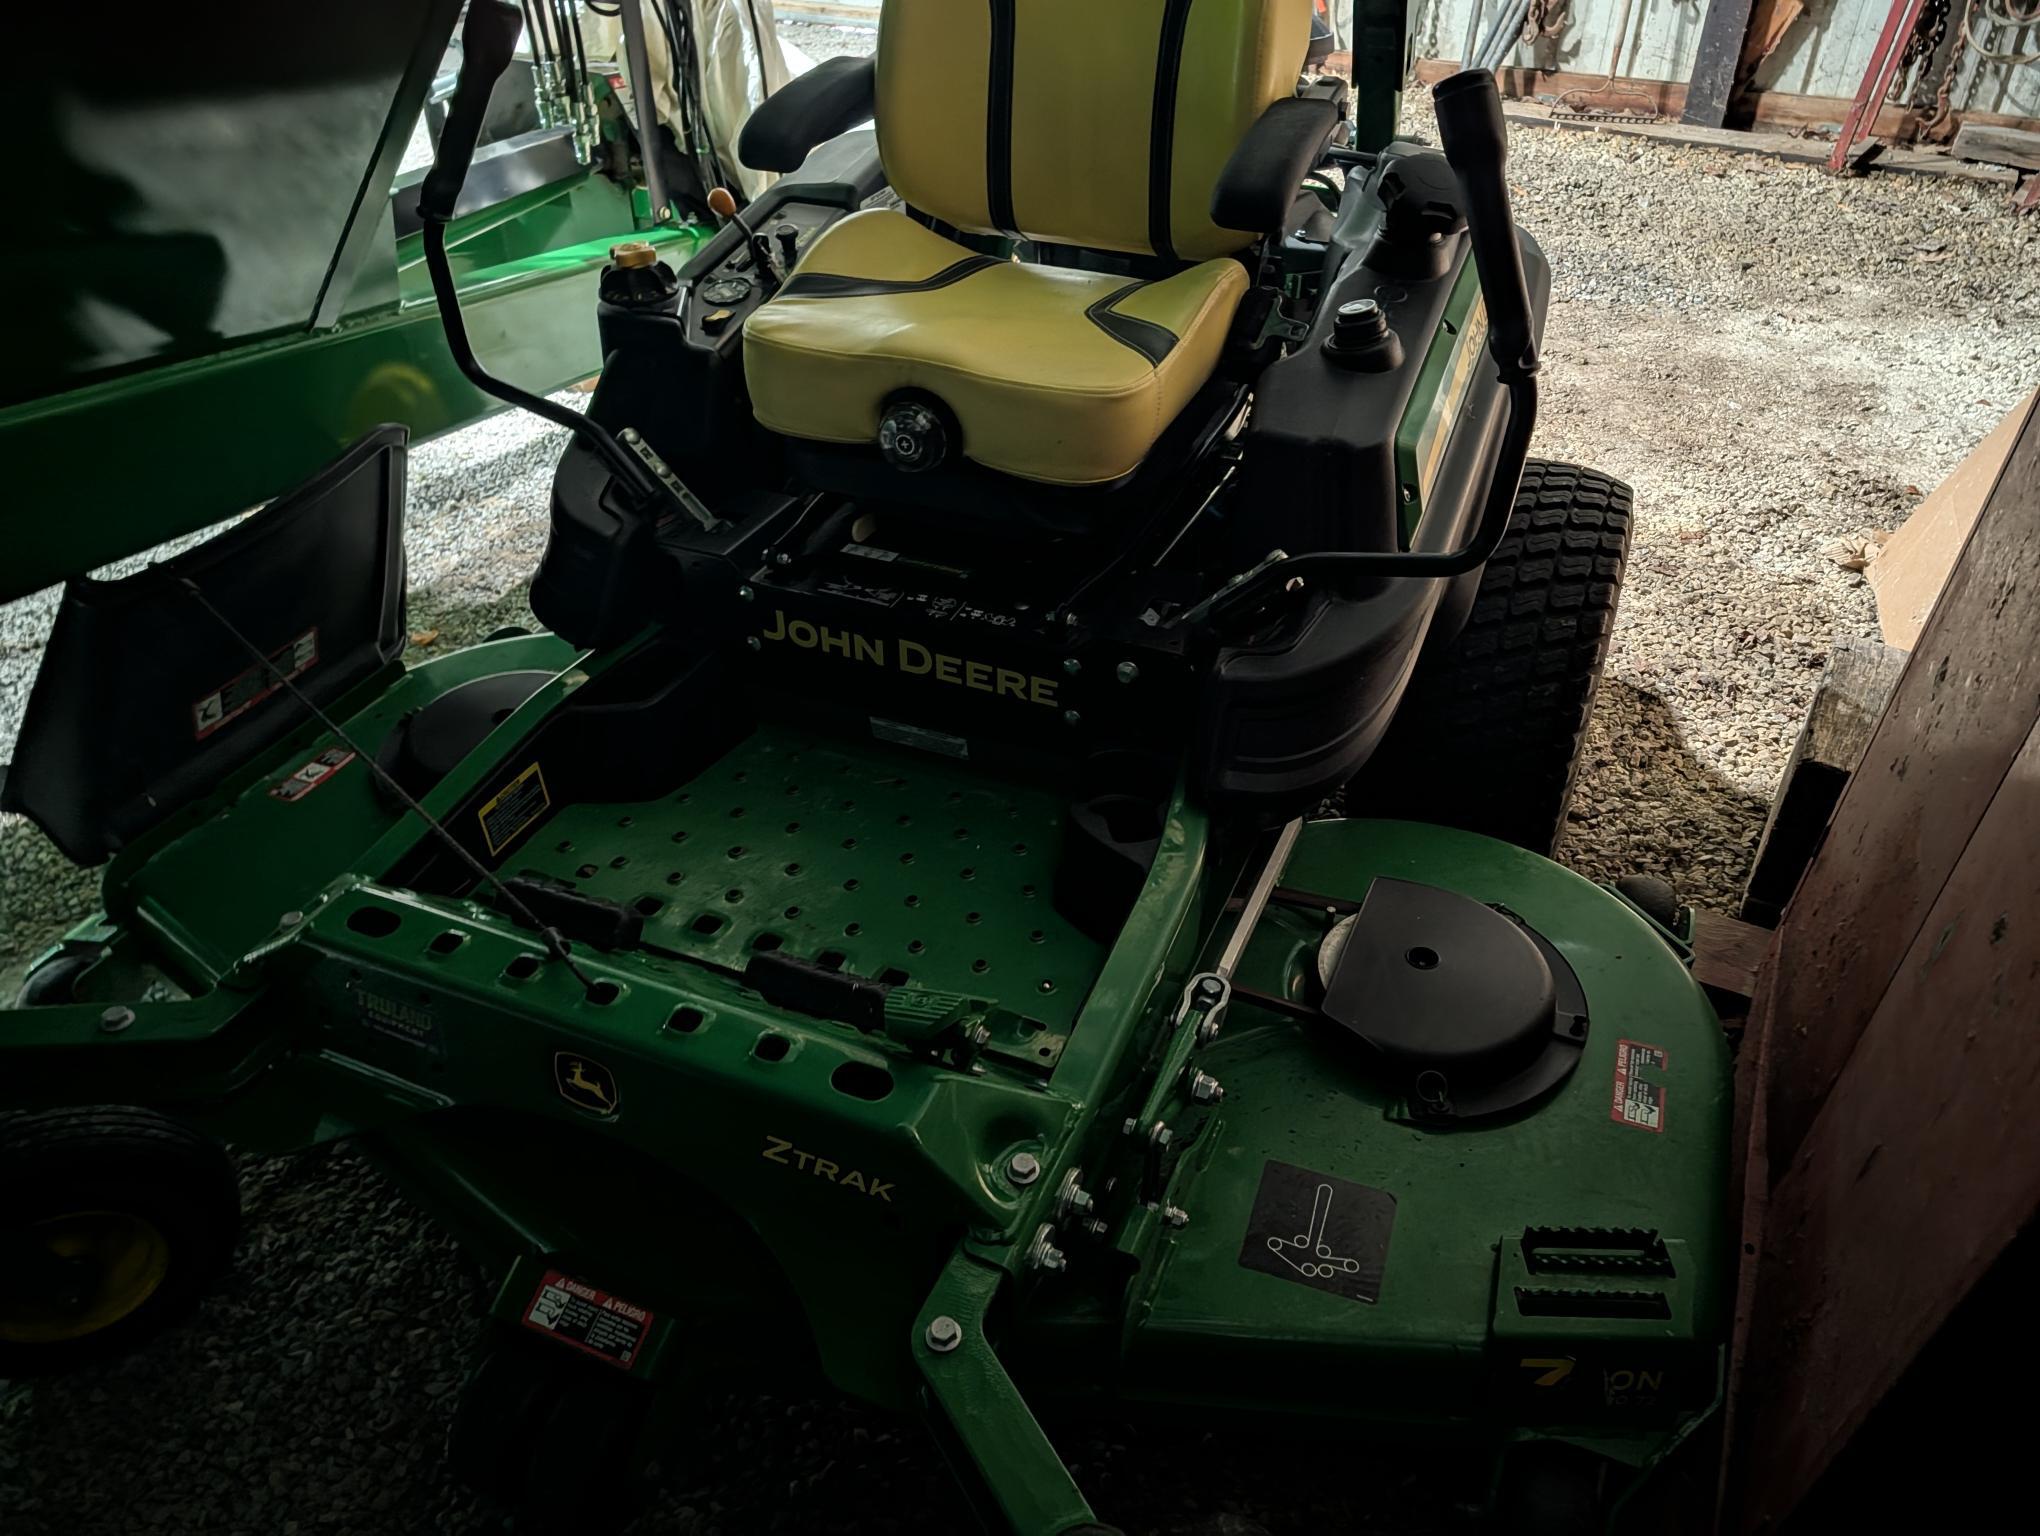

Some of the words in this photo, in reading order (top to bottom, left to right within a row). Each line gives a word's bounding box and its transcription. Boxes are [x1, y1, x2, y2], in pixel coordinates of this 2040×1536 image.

[763, 610, 886, 667] JOHN
[898, 638, 1060, 708] DEERE
[762, 1135, 897, 1202] ZTRAK
